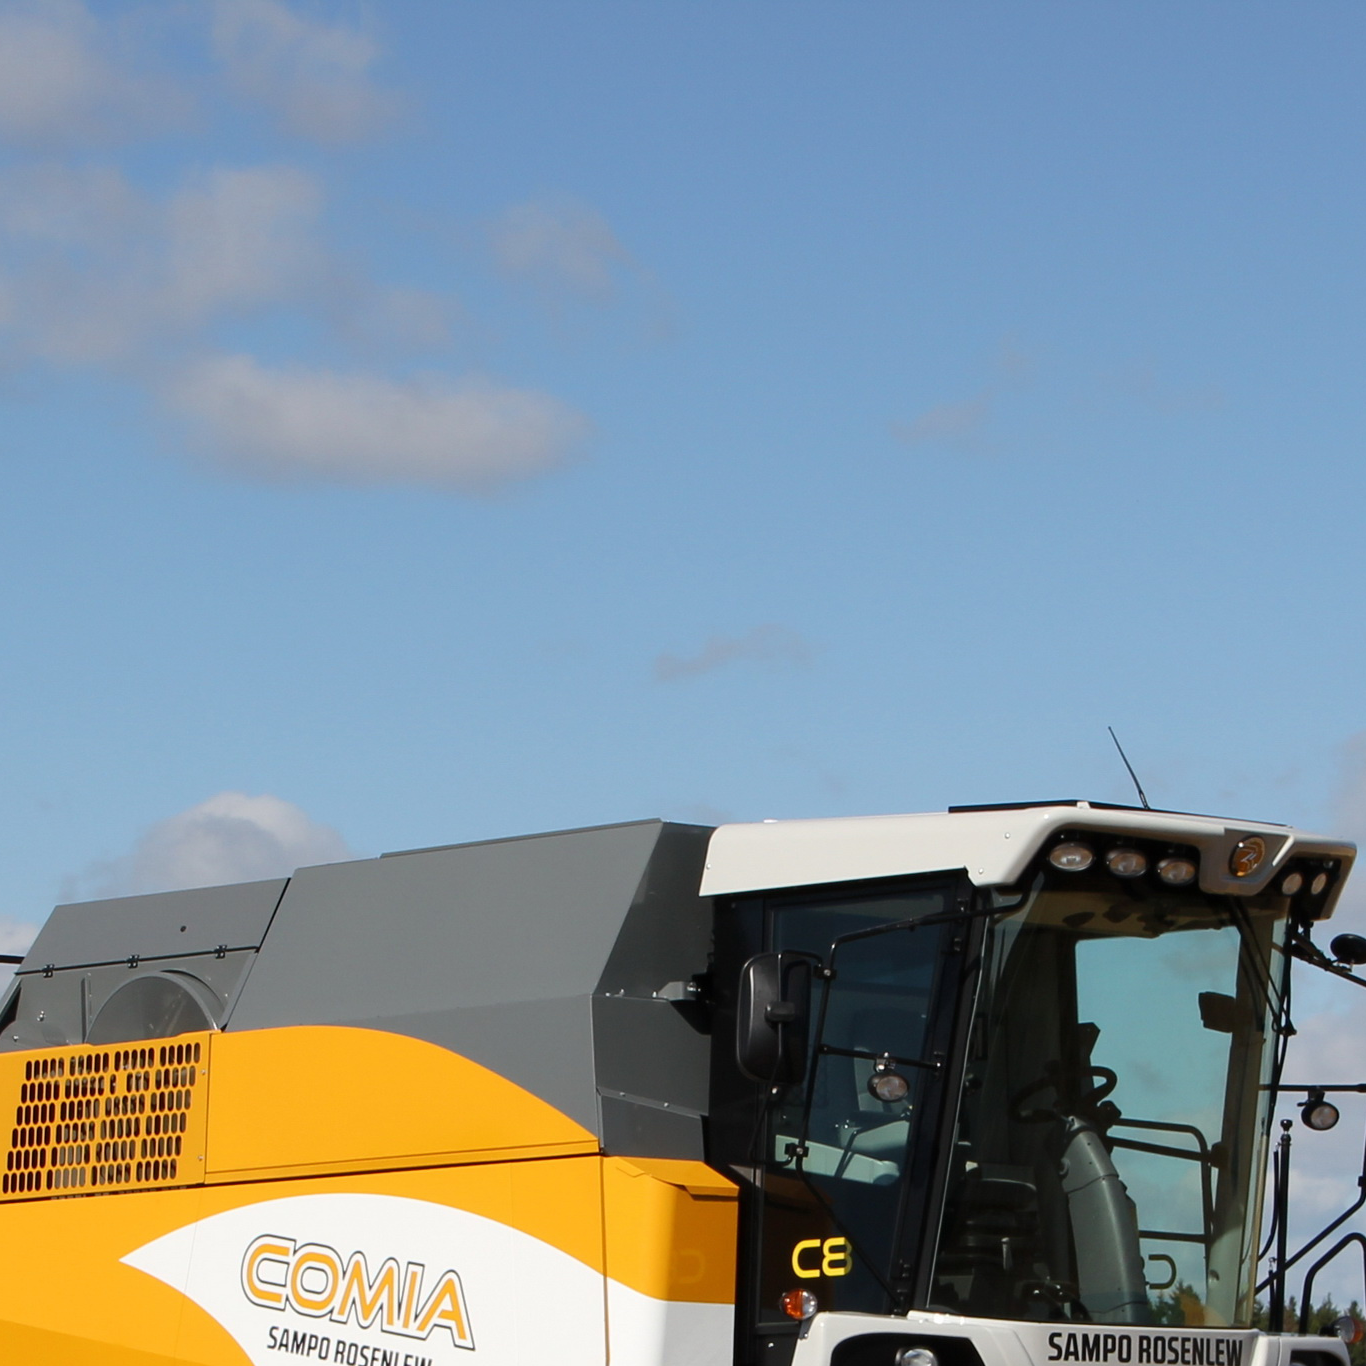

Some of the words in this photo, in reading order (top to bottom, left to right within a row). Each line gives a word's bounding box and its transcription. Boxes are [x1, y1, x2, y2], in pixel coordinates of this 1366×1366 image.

[791, 1236, 853, 1279] C8
[241, 1233, 477, 1352] COMIA
[266, 1325, 331, 1361] SAMPO
[1047, 1331, 1133, 1364] SAMPO
